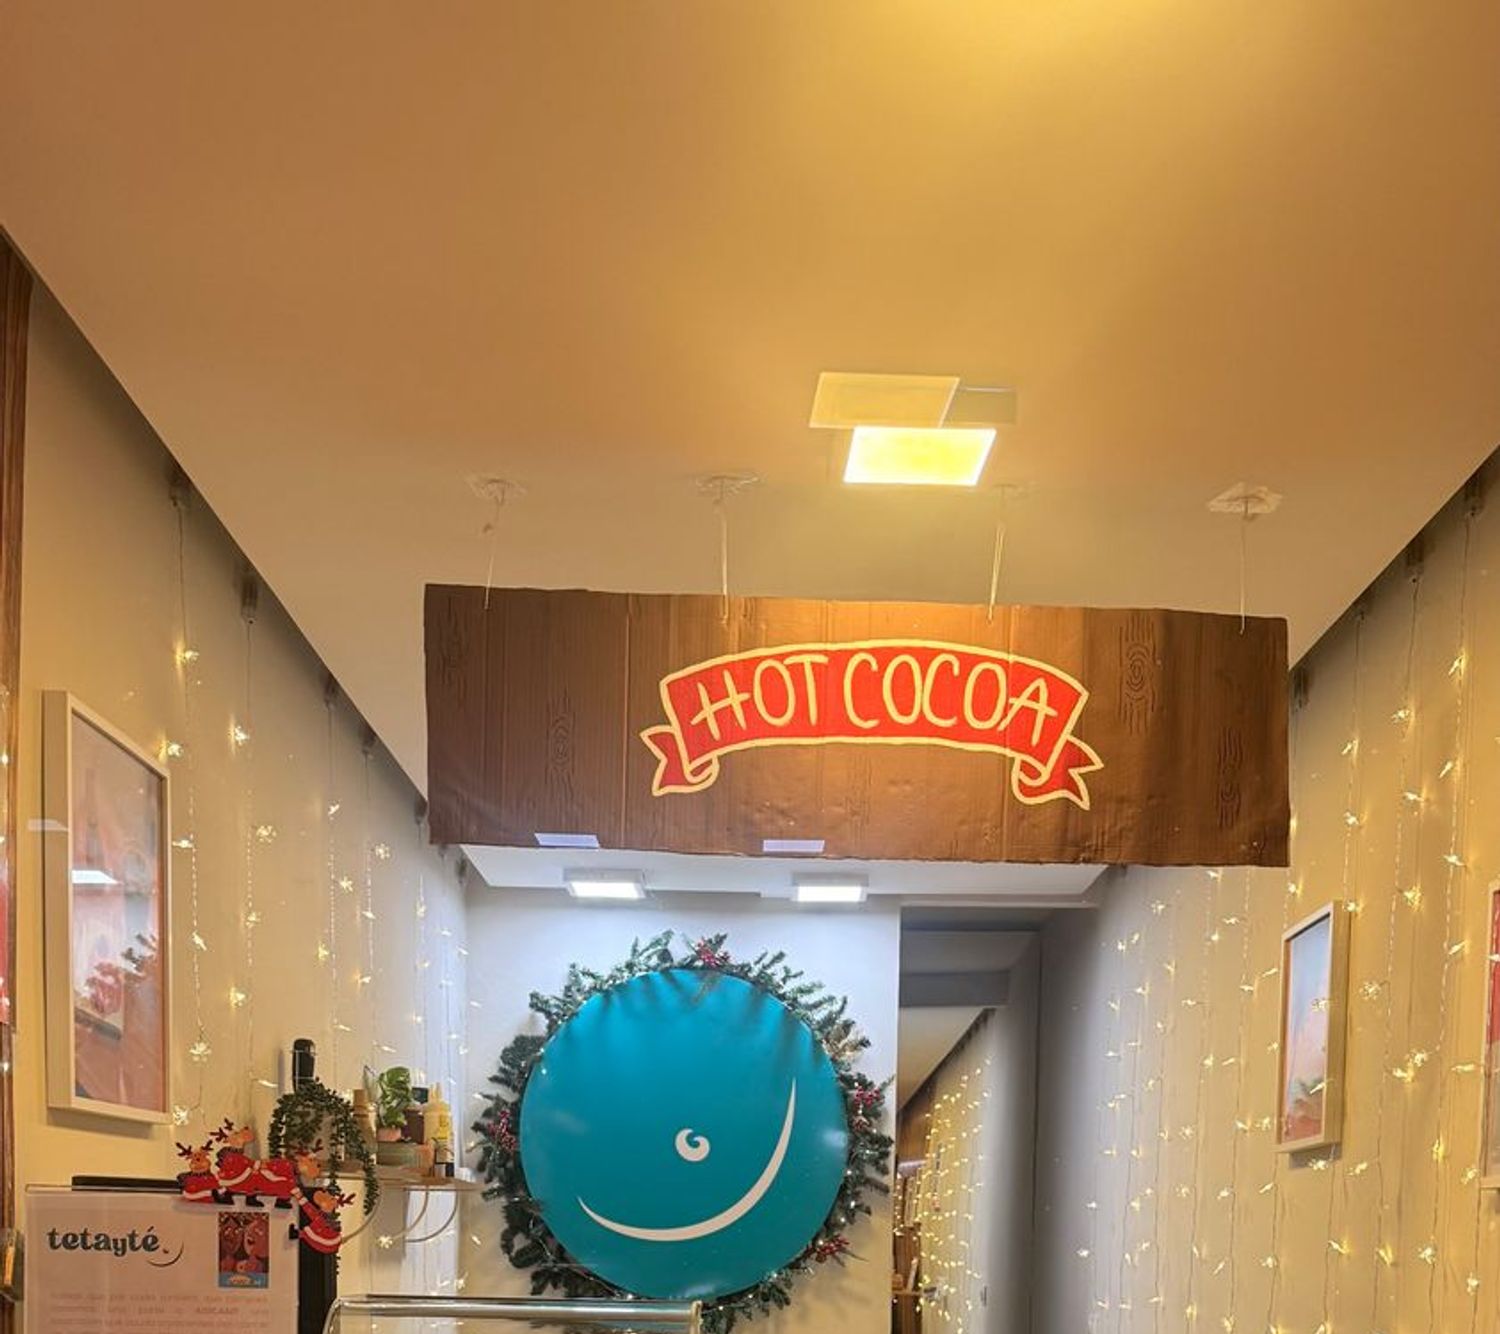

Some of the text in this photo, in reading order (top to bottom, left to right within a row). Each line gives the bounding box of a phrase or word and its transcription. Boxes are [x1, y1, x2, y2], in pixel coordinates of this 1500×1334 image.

[690, 652, 1058, 747] HOT COCOA
[47, 1226, 160, 1257] tetayté
